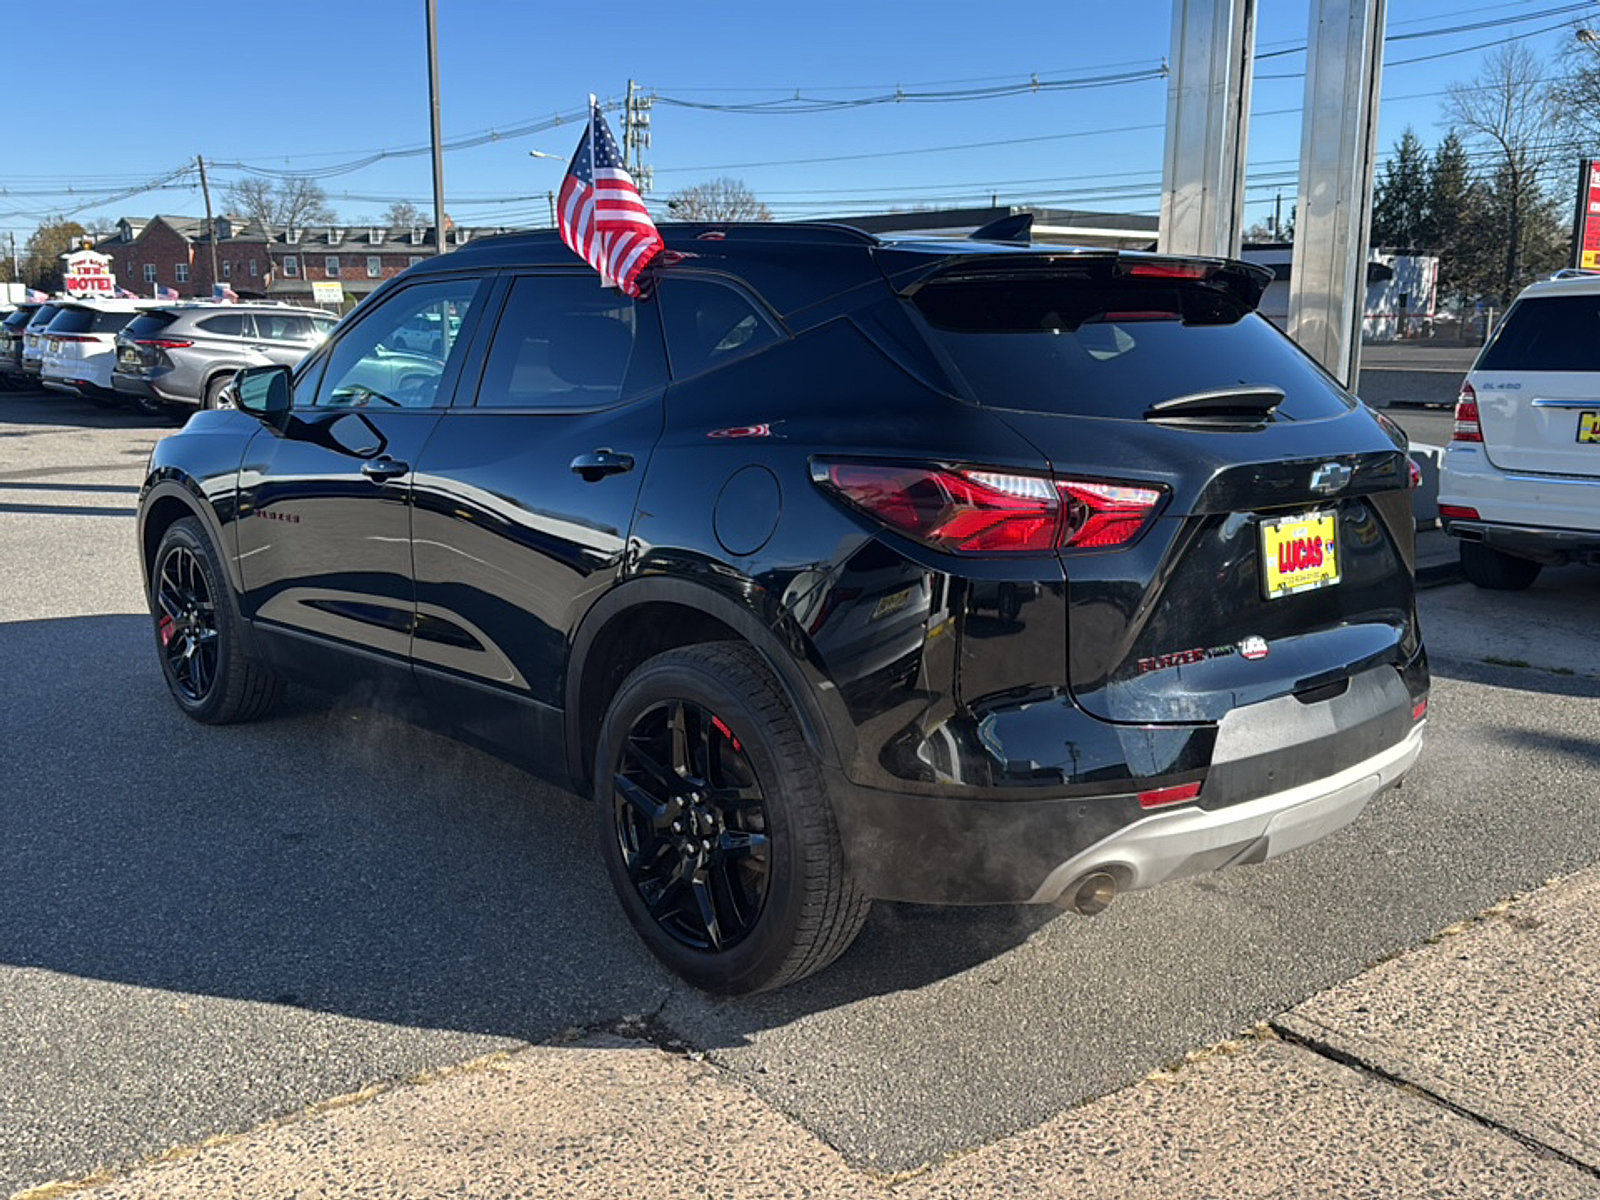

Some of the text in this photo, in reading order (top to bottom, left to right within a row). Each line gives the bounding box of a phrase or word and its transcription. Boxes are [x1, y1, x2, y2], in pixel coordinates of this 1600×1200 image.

[67, 277, 112, 290] MOTEL
[1279, 535, 1323, 574] LUCAS
[1138, 648, 1204, 672] BLAZER
